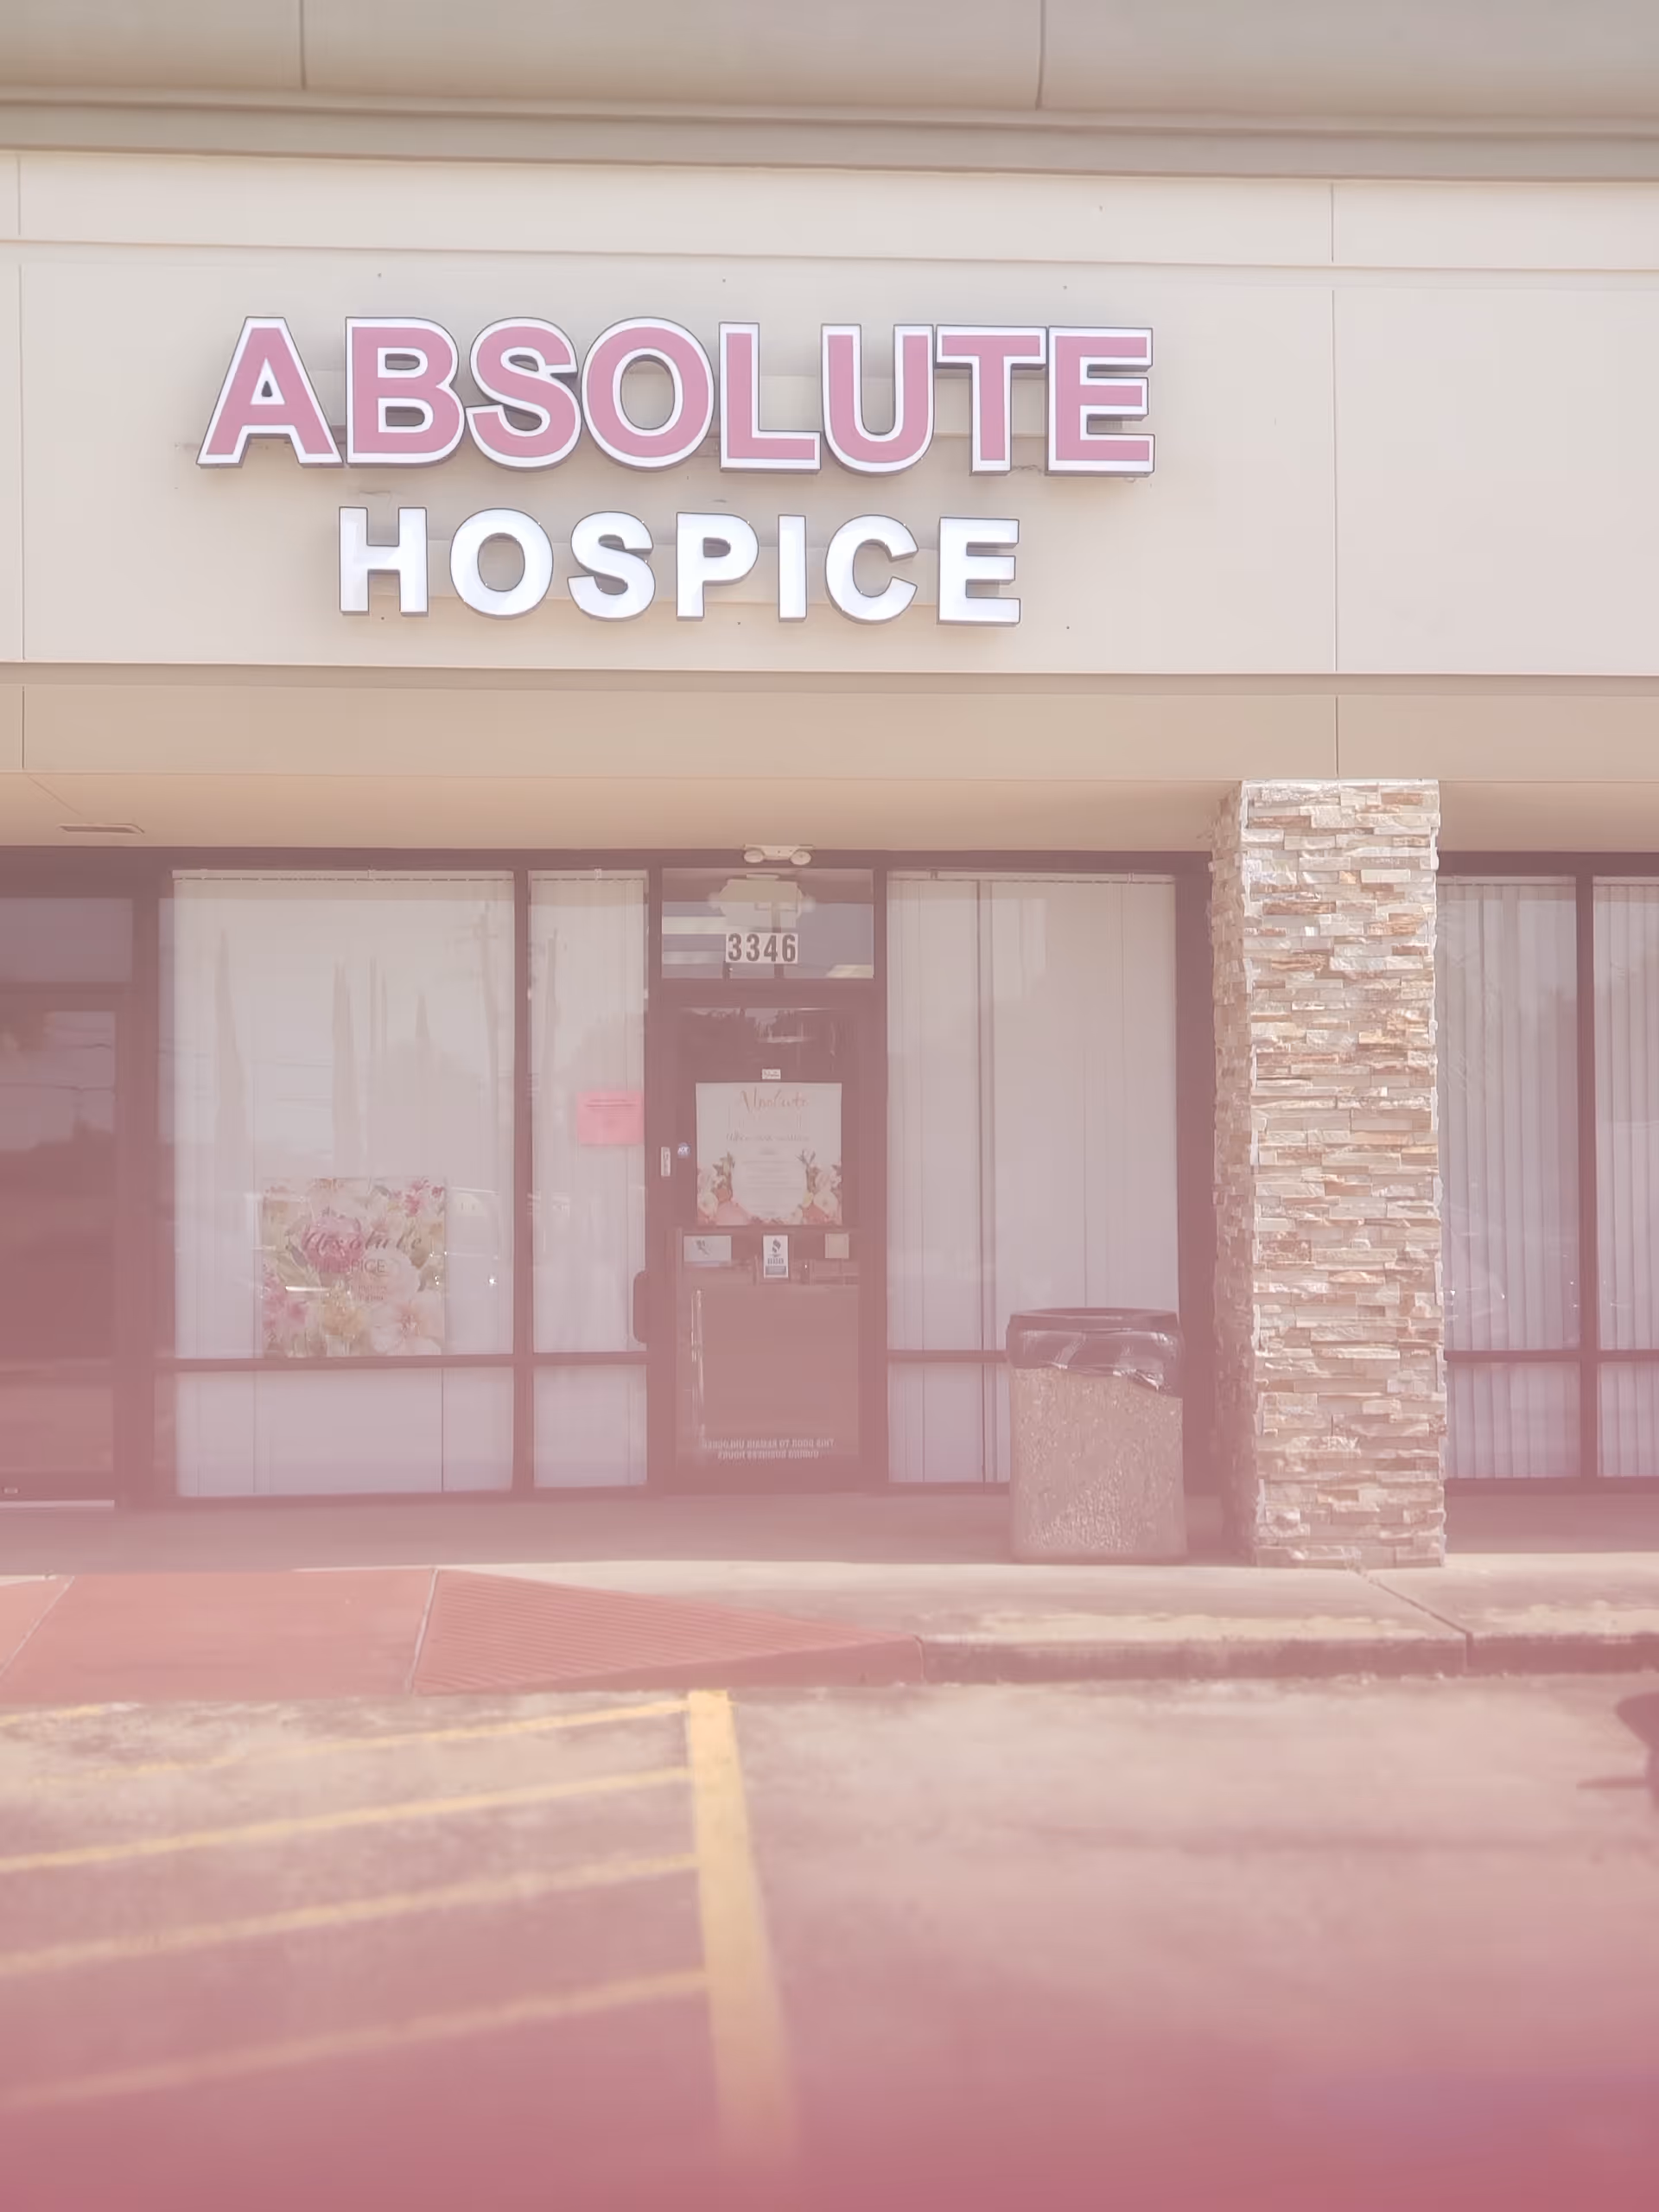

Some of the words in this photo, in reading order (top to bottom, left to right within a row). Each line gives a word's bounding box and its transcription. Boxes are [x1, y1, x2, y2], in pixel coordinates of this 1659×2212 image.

[196, 315, 1155, 476] ABSOLUTE
[339, 506, 1021, 626] HOSPICE
[728, 933, 797, 963] 3346
